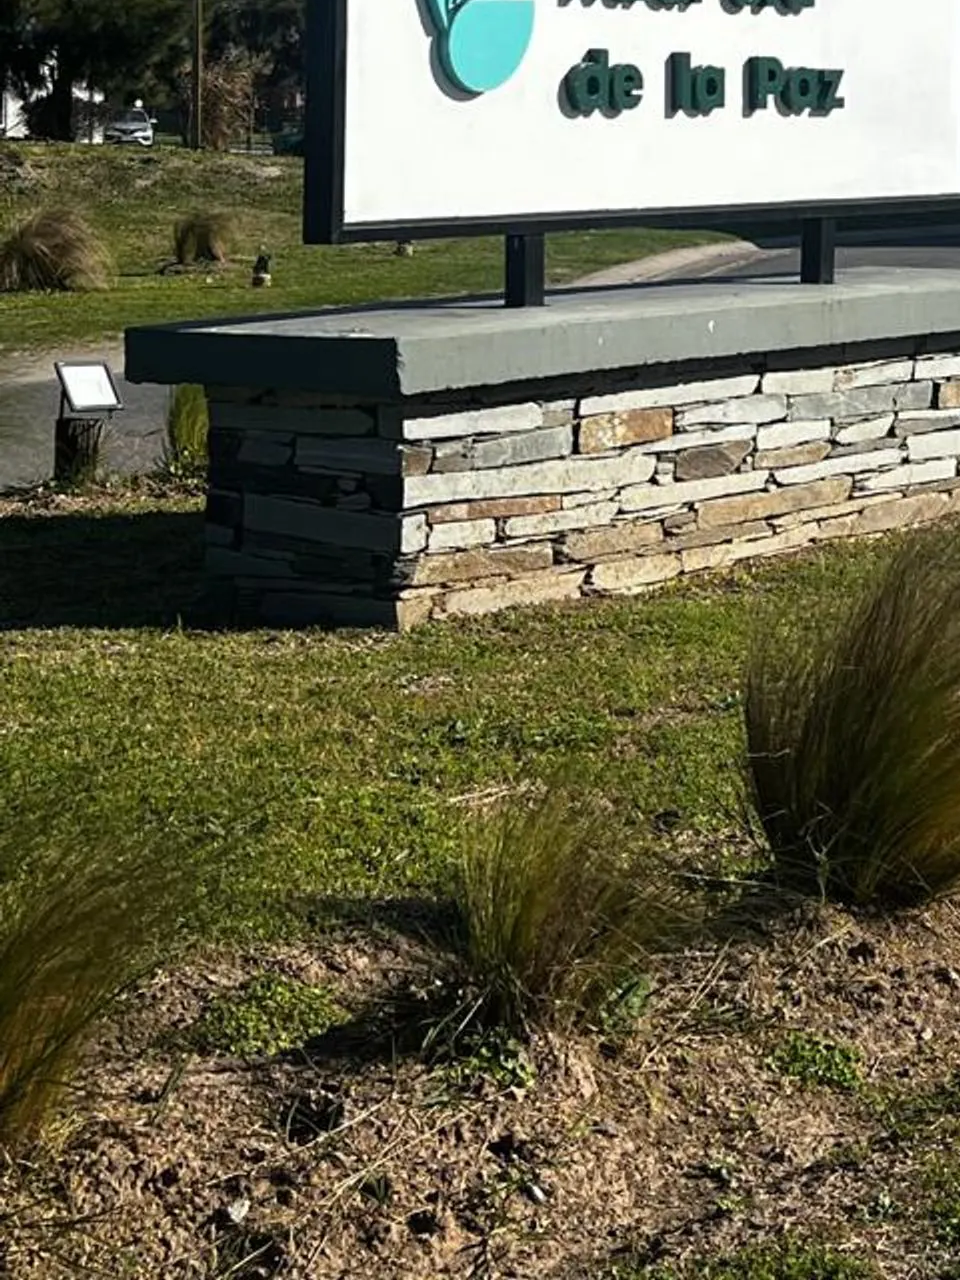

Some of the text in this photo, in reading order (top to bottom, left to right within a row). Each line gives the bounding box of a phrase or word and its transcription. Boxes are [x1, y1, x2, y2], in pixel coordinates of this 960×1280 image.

[559, 49, 844, 117] de la Paz
